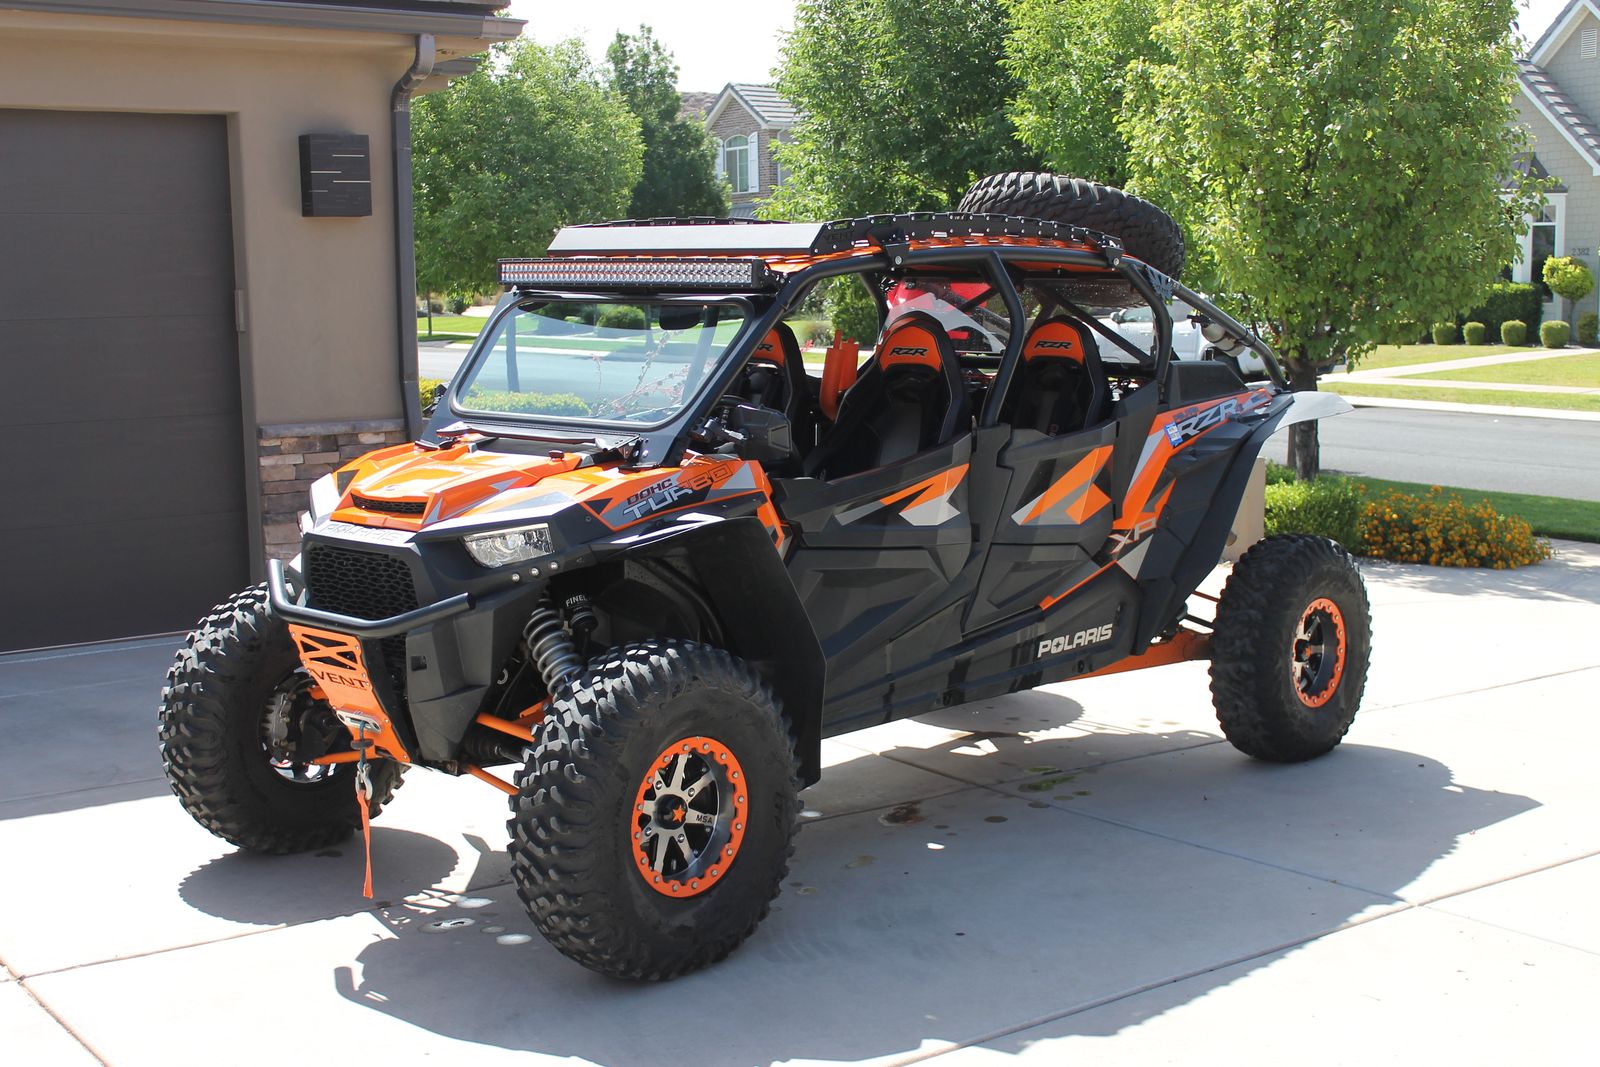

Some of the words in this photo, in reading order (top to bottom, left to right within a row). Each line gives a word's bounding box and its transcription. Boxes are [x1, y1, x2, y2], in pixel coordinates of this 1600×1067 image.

[889, 347, 929, 357] RZR
[1034, 340, 1073, 350] RZR
[1177, 398, 1239, 437] RZR
[623, 464, 733, 519] TURBO
[626, 479, 673, 505] DOHC
[1108, 517, 1157, 555] XP
[1037, 623, 1113, 658] POLARIS
[310, 668, 367, 688] VENT
[695, 814, 713, 824] MSA
